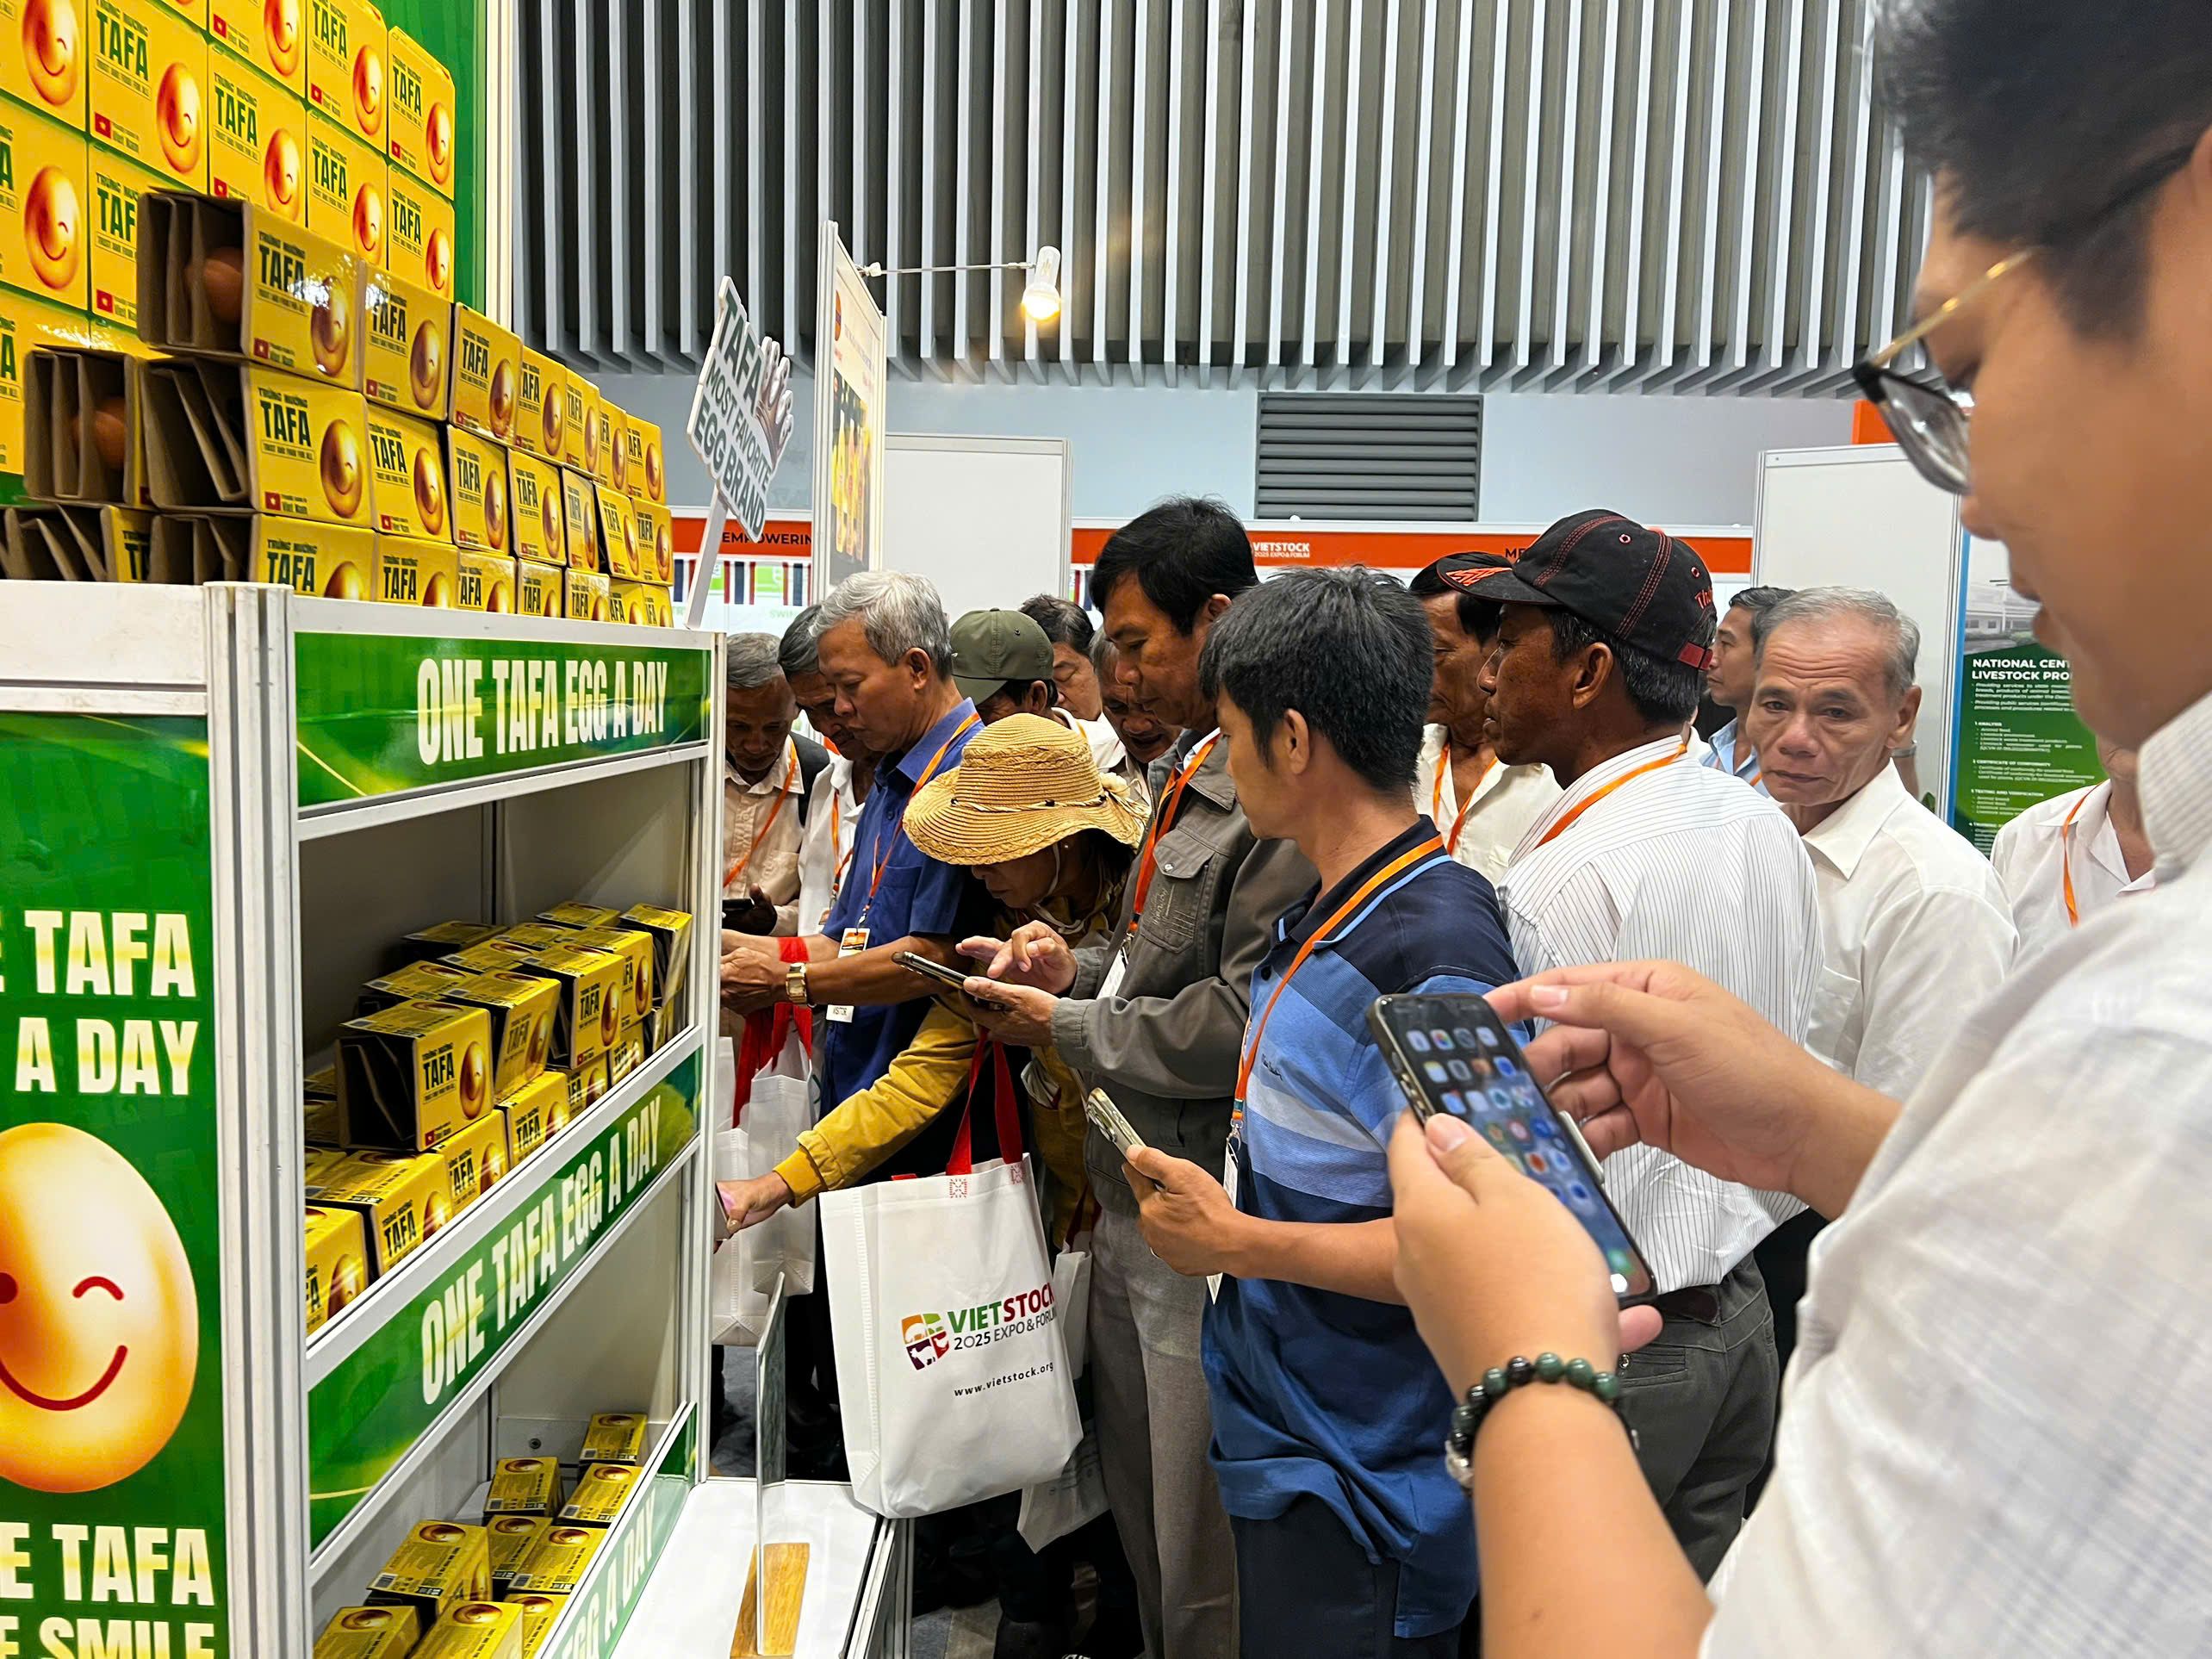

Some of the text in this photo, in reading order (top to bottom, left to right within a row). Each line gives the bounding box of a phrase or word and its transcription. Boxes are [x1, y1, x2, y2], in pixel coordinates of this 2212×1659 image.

[96, 9, 148, 81] TAFA
[313, 1, 347, 59] TAFA
[393, 65, 422, 116] TAFA
[215, 84, 258, 146] TAFA
[313, 148, 347, 201] TAFA
[97, 188, 135, 242] TAF
[393, 200, 422, 245] TAFA
[259, 245, 305, 299] TAFA
[463, 338, 488, 378] TAFA
[719, 288, 761, 415] TAFA
[522, 370, 540, 403] AFA
[260, 400, 311, 447] TAFA
[567, 391, 582, 424] TAFA
[706, 358, 772, 494] MOST FAVORITE
[370, 433, 407, 473] TAFA
[627, 434, 643, 458] AFA
[457, 457, 481, 494] TAFA
[693, 396, 765, 537] EGG BRAND
[517, 478, 538, 508] TAFA
[605, 507, 621, 533] TAFA
[637, 519, 653, 542] TAFA
[722, 531, 811, 545] EMPOWERIN
[1252, 542, 1309, 551] VIETSTOCK
[267, 551, 315, 592] TAFA
[383, 567, 417, 600] TAFA
[460, 575, 482, 606] AFA
[524, 586, 541, 614] TAFA
[572, 592, 588, 618] TAFA
[610, 595, 625, 622] AFA
[1972, 671, 2072, 680] LIVESTOCK PRO
[1973, 659, 2036, 668] NATIONAL
[417, 658, 668, 765] ONE TAFA EGG A DAY
[24, 910, 196, 997] TAFA
[581, 991, 600, 1021] TAFA
[15, 1017, 199, 1095] A DAY
[507, 1020, 530, 1055] TAFA
[423, 1052, 455, 1090] TAFA
[516, 1115, 541, 1149] TAFA
[384, 1211, 417, 1257] TAFA
[421, 1096, 661, 1405] ONE TAFA EGG A DAY
[954, 1332, 991, 1350] 2025
[994, 1321, 1025, 1341] EXPO
[1027, 1319, 1035, 1332] &
[954, 1362, 1053, 1396] www.vietstock.org
[52, 1524, 214, 1606] TAFA
[606, 1557, 618, 1643] A
[623, 1488, 656, 1608] DAY
